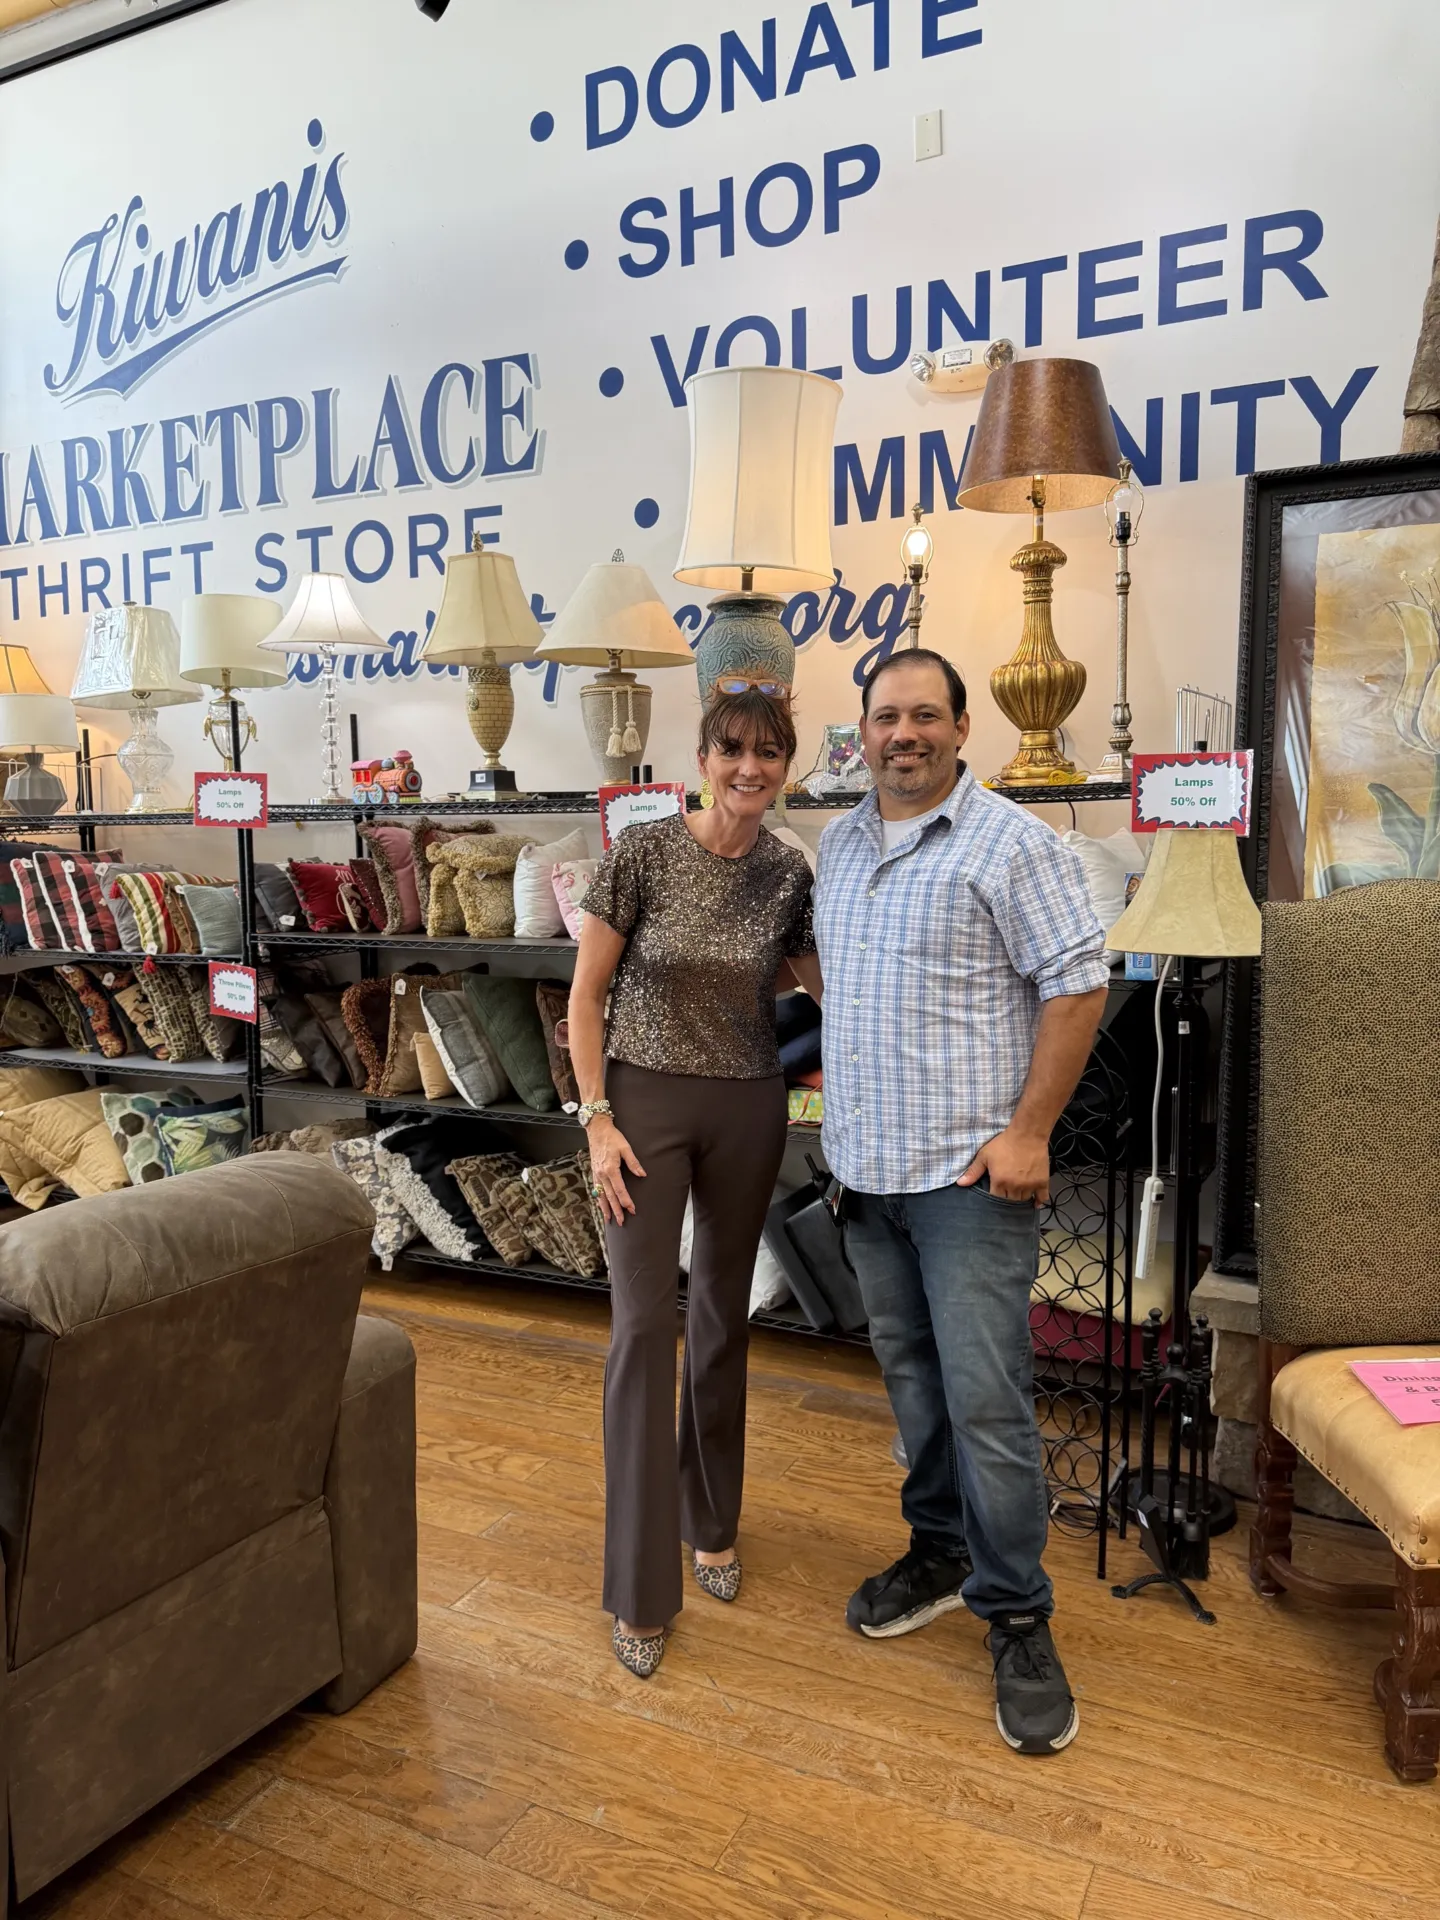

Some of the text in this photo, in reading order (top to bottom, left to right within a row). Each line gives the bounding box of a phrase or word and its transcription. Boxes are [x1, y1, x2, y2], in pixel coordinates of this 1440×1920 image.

[585, 0, 983, 151] DONATE
[618, 143, 881, 279] SHOP
[43, 118, 349, 391] Kiwanis
[650, 209, 1329, 408] VOLUNTEER
[0, 504, 503, 621] THRIFT STORE
[216, 801, 245, 809] 50% Off
[218, 788, 242, 797] Lamps
[629, 804, 658, 812] Lamps
[1170, 797, 1217, 807] 50% Off
[1174, 777, 1214, 788] Lamps
